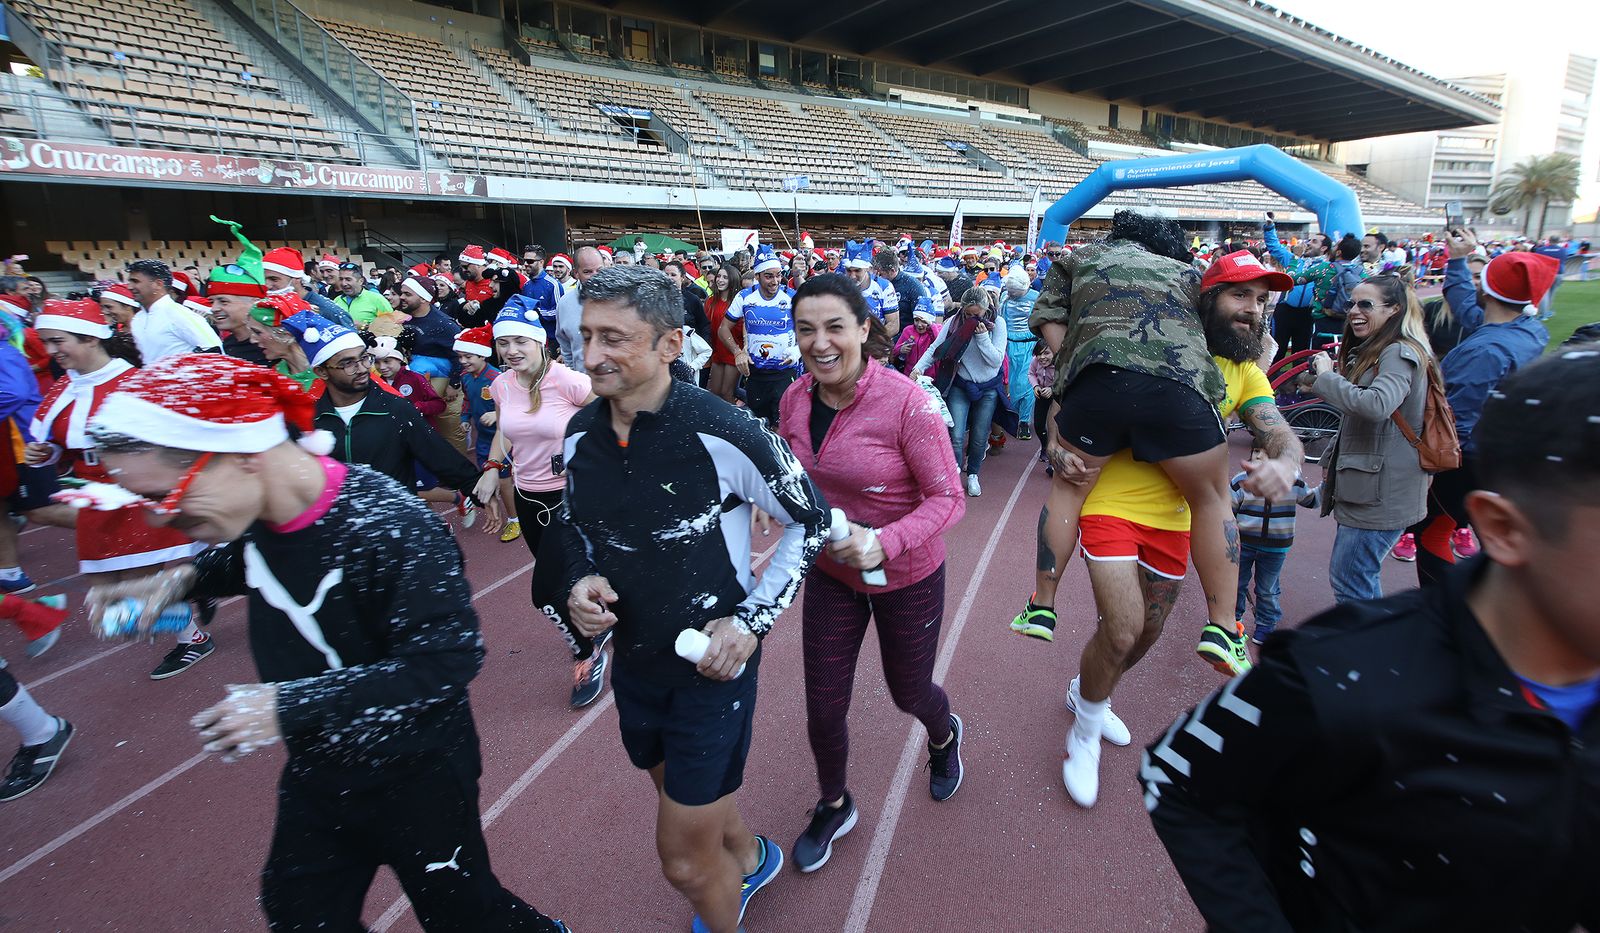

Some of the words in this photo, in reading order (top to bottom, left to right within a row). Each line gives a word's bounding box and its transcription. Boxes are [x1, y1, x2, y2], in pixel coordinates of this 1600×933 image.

[31, 142, 183, 178] Cruzcampo
[1127, 164, 1192, 174] Ayuntamiento
[1208, 159, 1235, 168] Jerez
[318, 165, 414, 191] Cruzcampo
